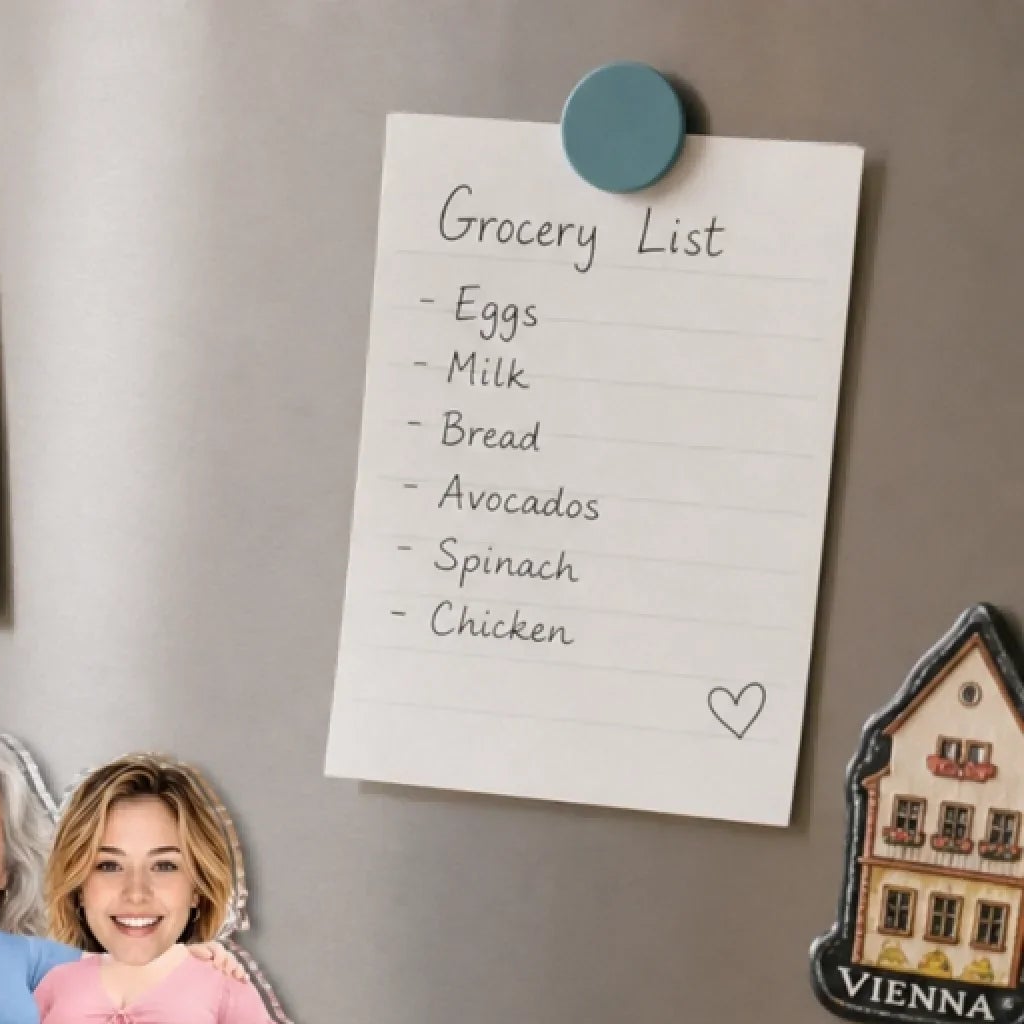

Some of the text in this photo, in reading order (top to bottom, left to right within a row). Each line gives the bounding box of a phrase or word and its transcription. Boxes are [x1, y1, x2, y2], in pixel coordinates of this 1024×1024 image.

[439, 183, 725, 273] Grocery List
[455, 284, 539, 342] Eggs
[447, 350, 531, 389] Milk
[441, 409, 541, 452] Bread
[437, 473, 600, 521] Avocados
[433, 537, 579, 586] Spinach
[431, 600, 575, 645] Chicken
[838, 965, 995, 1021] VIENNA
